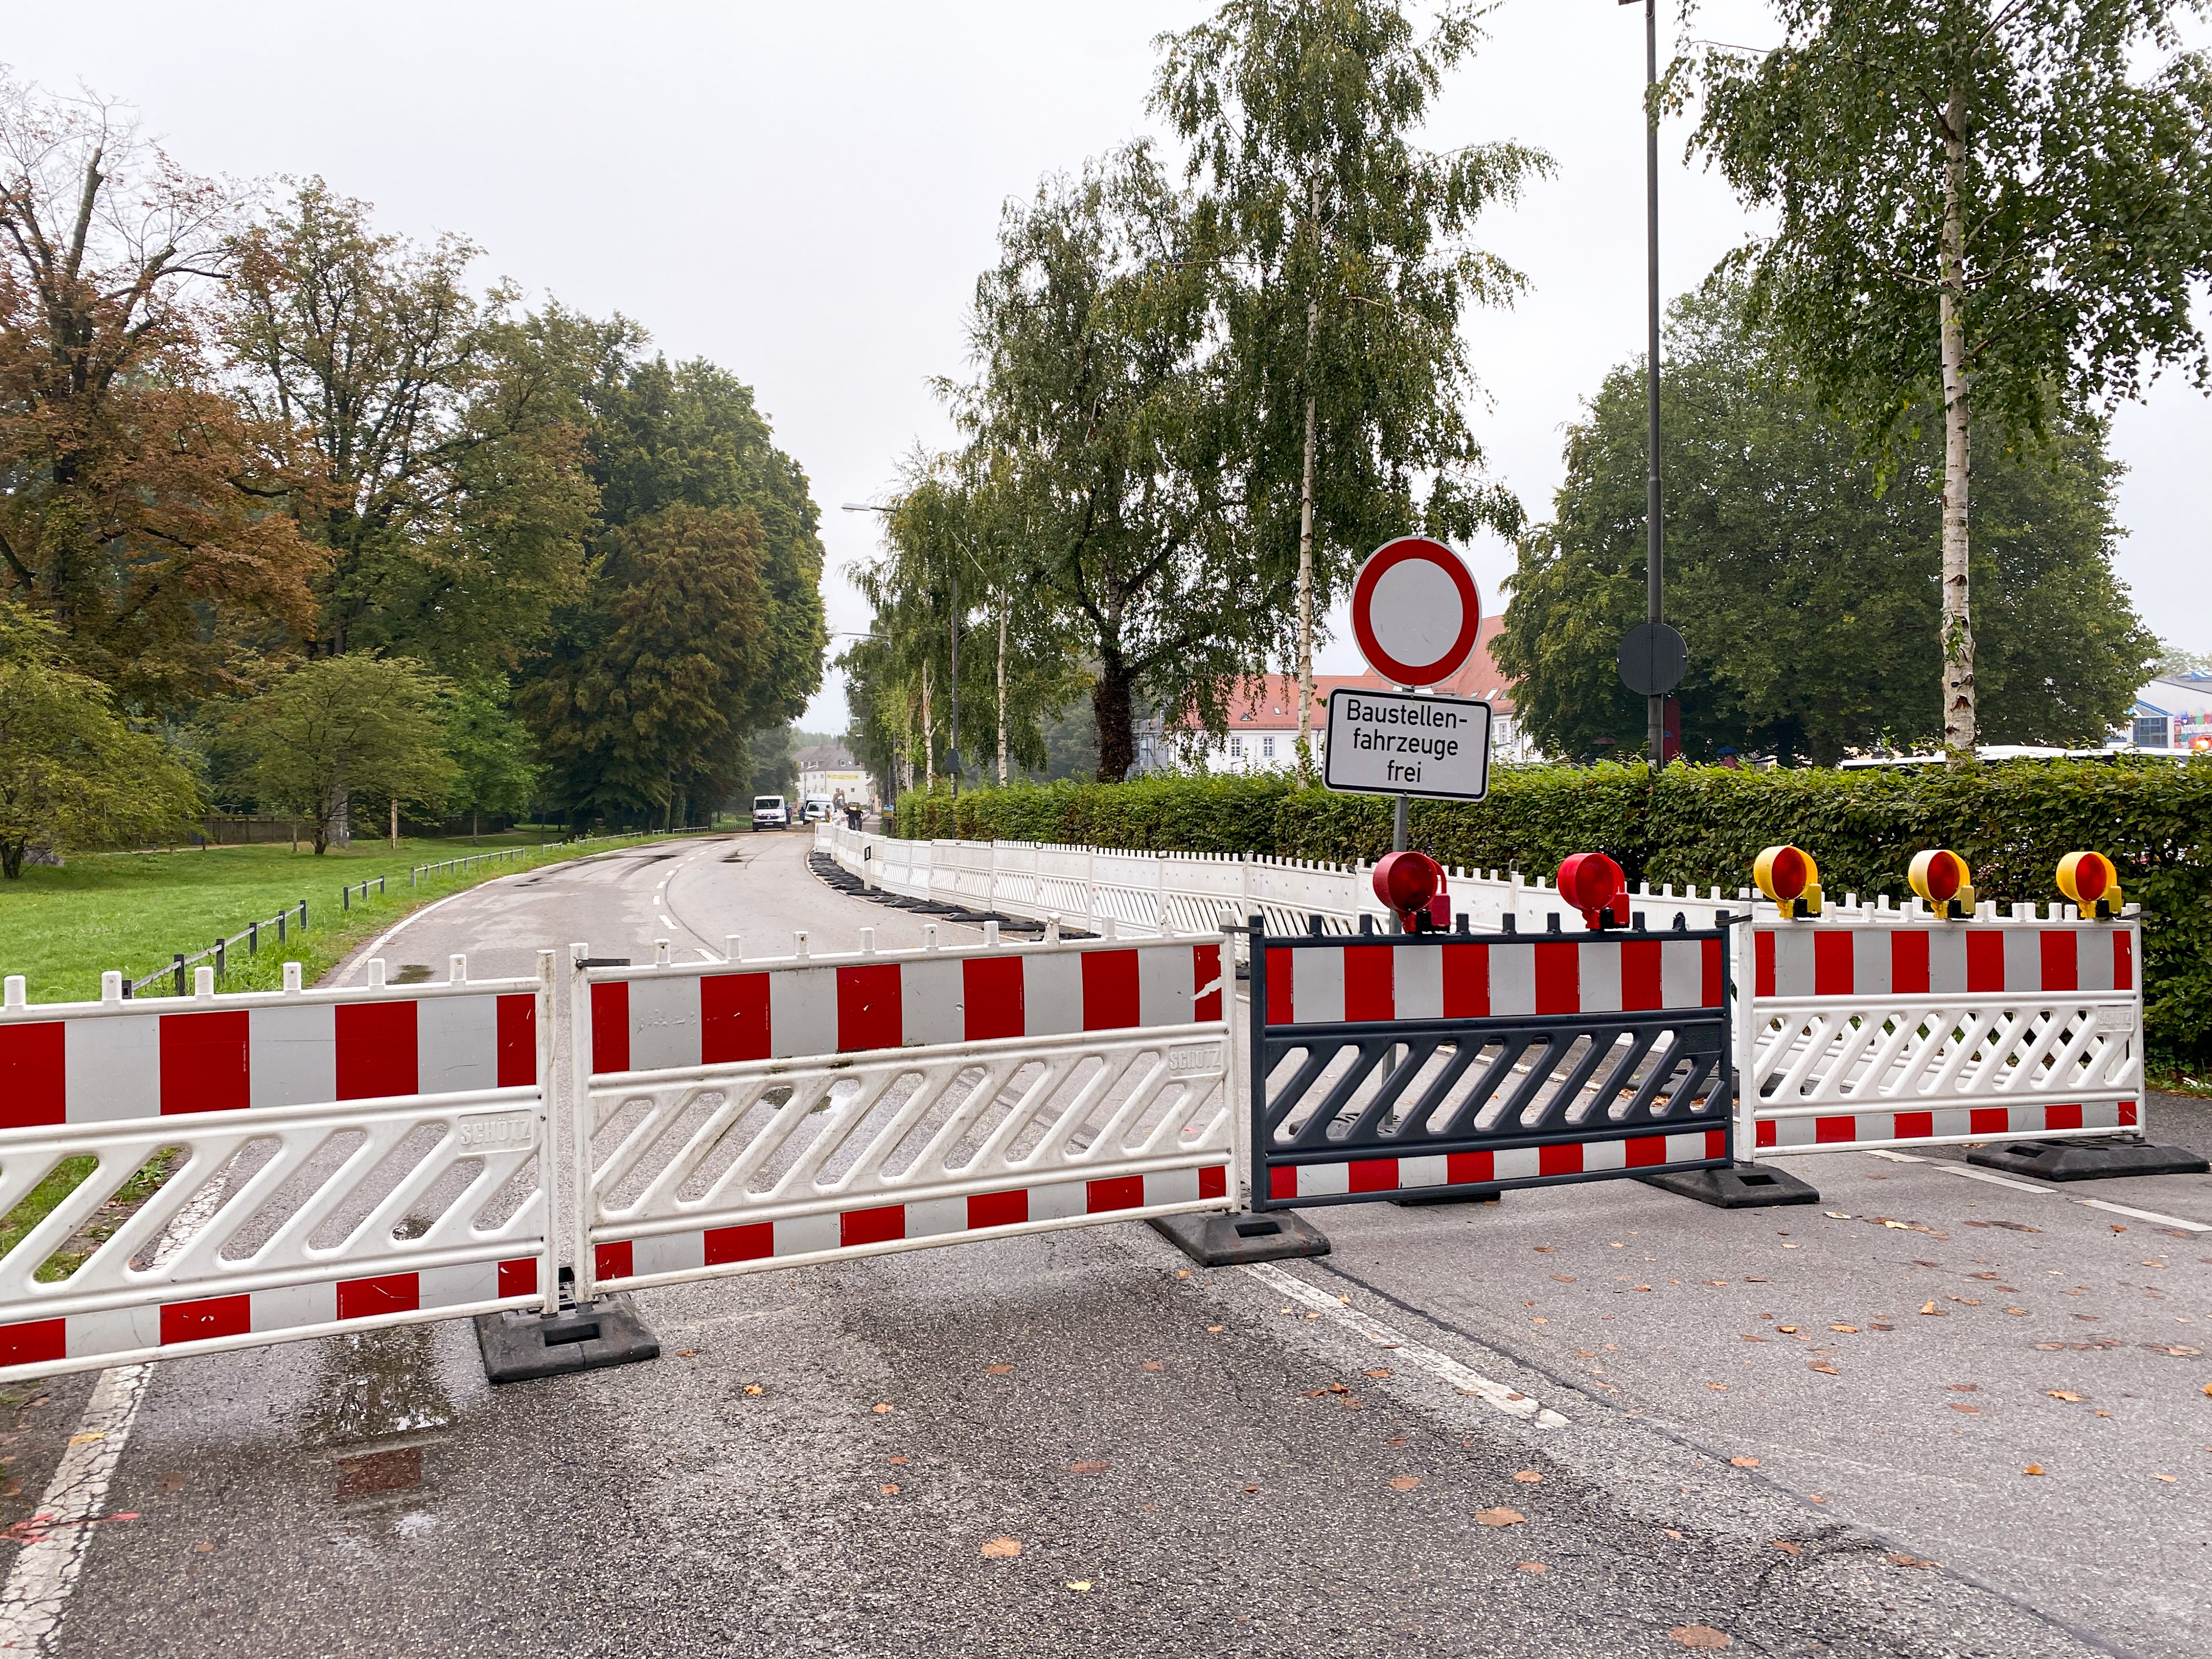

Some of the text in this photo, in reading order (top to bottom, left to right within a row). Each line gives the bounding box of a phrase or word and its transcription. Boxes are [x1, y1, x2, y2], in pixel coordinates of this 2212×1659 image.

[1347, 698, 1468, 729] Baustellen-
[1353, 727, 1458, 761] fahrzeuge
[1387, 760, 1422, 783] frei
[1169, 1047, 1221, 1070] SCHÖTZ
[460, 1117, 531, 1146] SCHÖTZ
